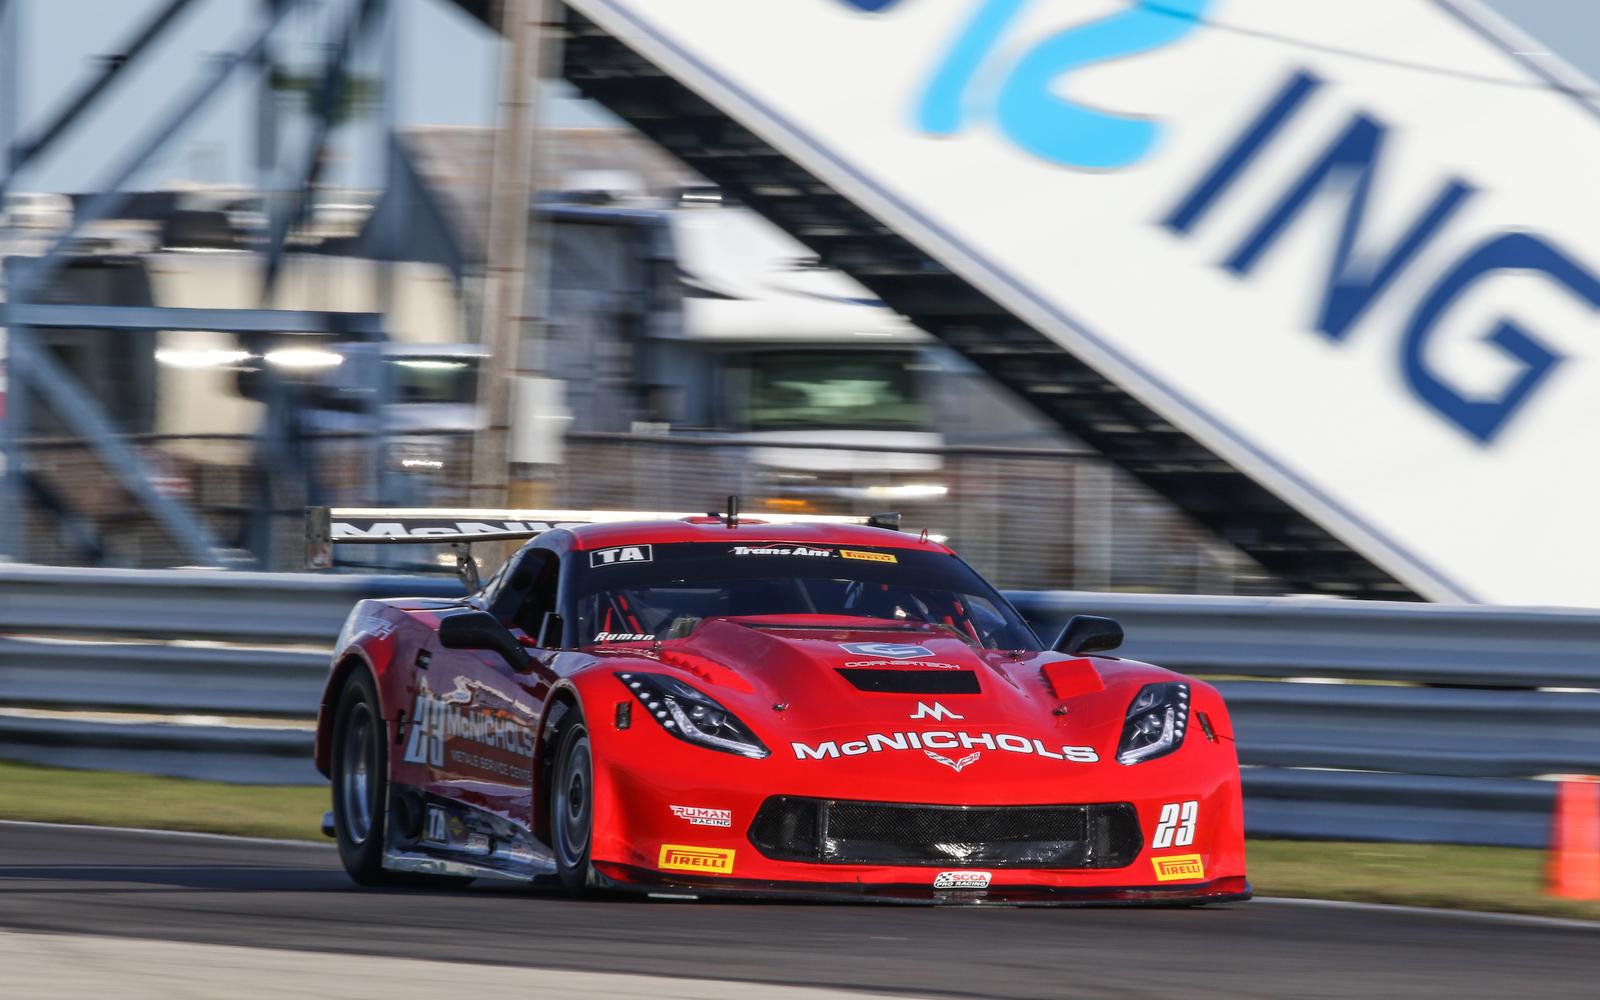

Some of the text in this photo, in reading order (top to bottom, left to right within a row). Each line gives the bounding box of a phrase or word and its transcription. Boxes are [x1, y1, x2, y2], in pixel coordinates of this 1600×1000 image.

[597, 547, 645, 563] TA
[845, 551, 892, 561] PIRELLI
[593, 631, 656, 641] Ruman
[404, 695, 446, 768] 23
[446, 703, 535, 759] McNICHOLS
[791, 731, 1100, 763] McNICHOLS
[673, 807, 732, 819] RUMAN
[691, 818, 731, 826] RACING
[1151, 800, 1198, 849] 23
[664, 849, 728, 868] PIRELLI
[1157, 859, 1201, 876] PIRELLI
